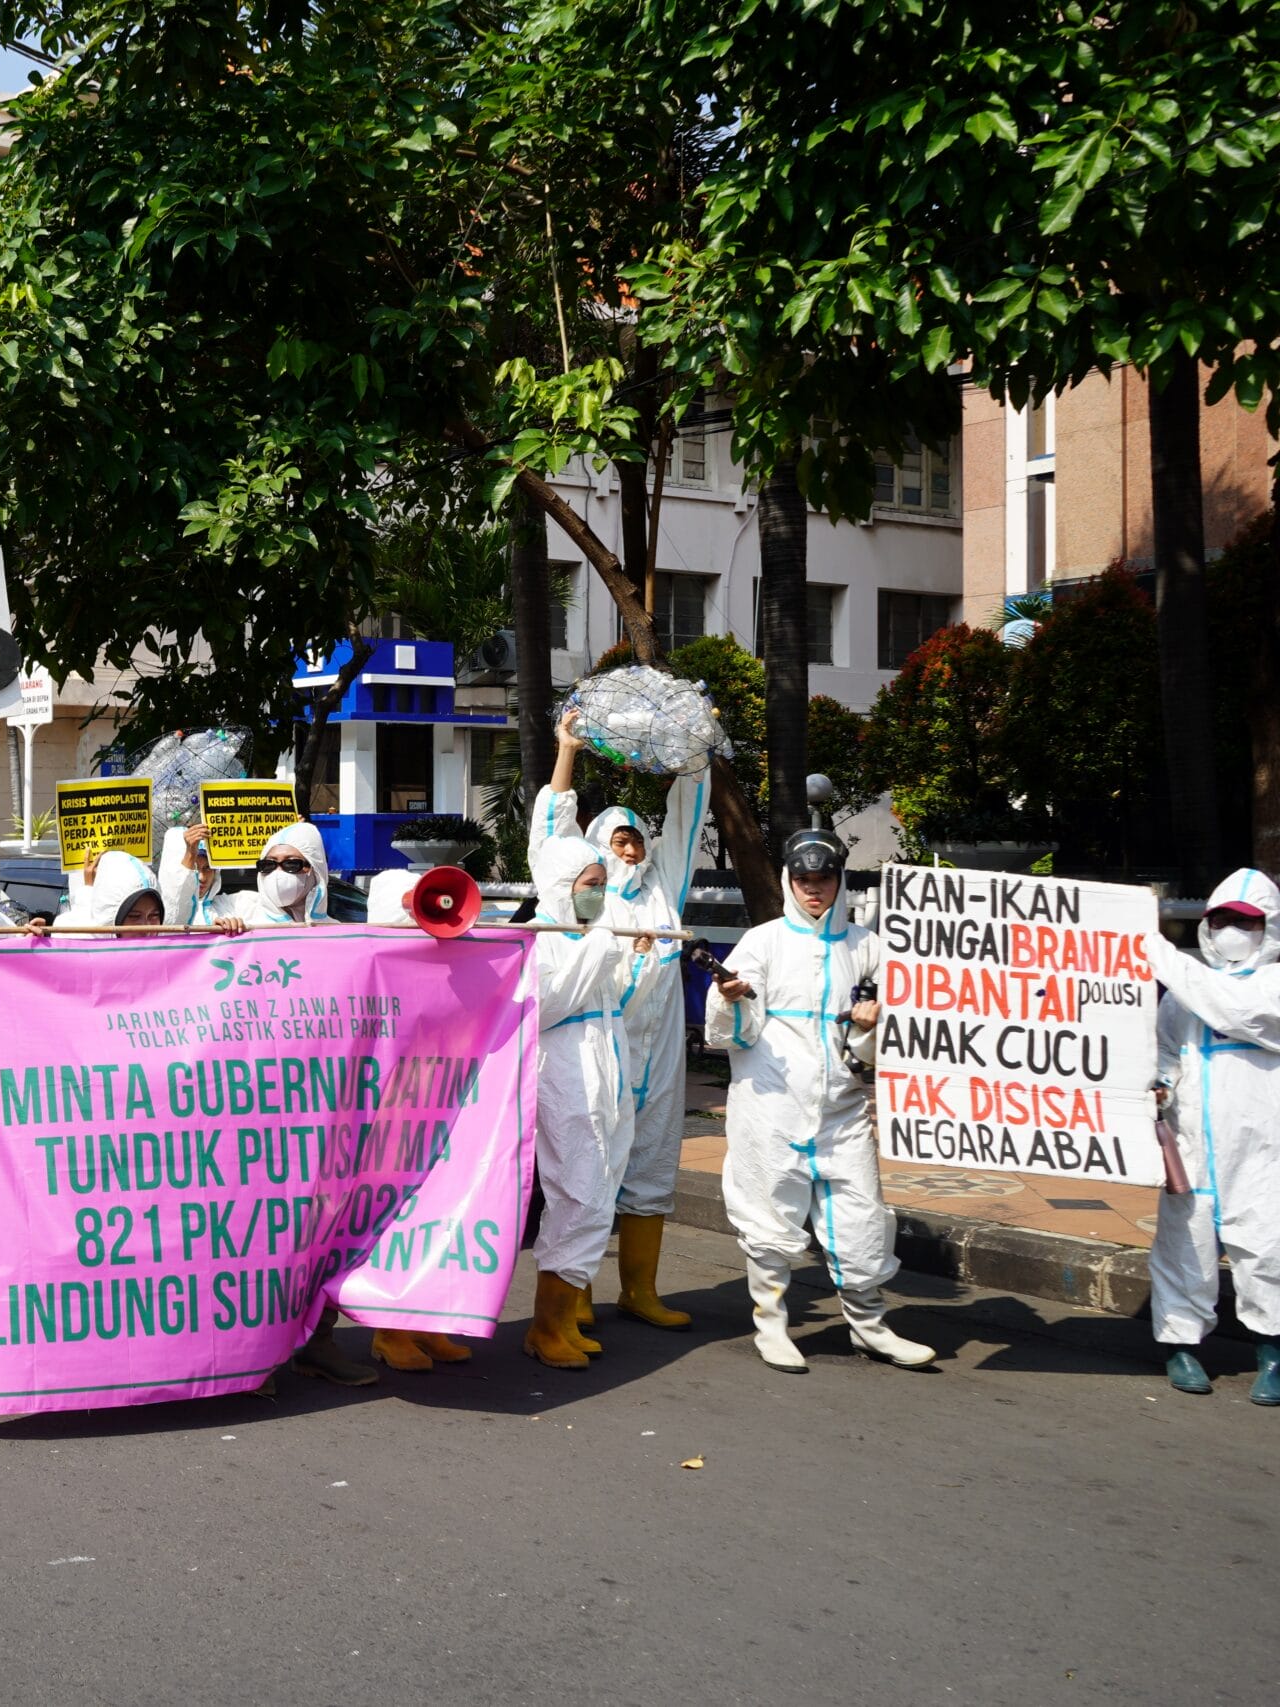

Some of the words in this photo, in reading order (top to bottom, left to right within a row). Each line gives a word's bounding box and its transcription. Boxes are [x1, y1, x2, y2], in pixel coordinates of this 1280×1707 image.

[62, 798, 87, 809] KRISIS
[90, 794, 146, 806] MIKROPLASTIK
[208, 797, 235, 807] KRISIS
[238, 797, 292, 806] MIKROPLASTIK
[64, 817, 78, 827] GEN
[81, 816, 86, 825] Z
[91, 814, 117, 824] JATIM
[120, 812, 146, 821] DUKUNG
[64, 828, 96, 840] PERDA
[101, 824, 146, 836] LARANGAN
[210, 816, 227, 824] GEN
[230, 815, 234, 823] Z
[238, 815, 262, 823] JATIM
[265, 814, 294, 822] DUKUNG
[211, 827, 242, 836] PERDA
[246, 826, 288, 836] LARANG
[67, 840, 99, 851] PLASTIK
[102, 837, 126, 847] SEKALI
[128, 836, 145, 844] PAKAI
[213, 839, 244, 848] PLASTIK
[885, 868, 1080, 923] IKAN-IKAN
[885, 914, 1009, 966] SUNGAI
[1010, 924, 1153, 982] BRANTAS
[886, 960, 1078, 1022] DIBANTAI
[107, 1004, 211, 1030] JARINGAN
[221, 1000, 260, 1020] GEN
[268, 999, 279, 1018] Z
[290, 996, 340, 1017] JAWA
[348, 996, 401, 1017] TIMUR
[126, 1028, 190, 1049] TOLAK
[197, 1020, 276, 1042] PLASTIK
[283, 1019, 344, 1040] SEKALI
[351, 1019, 397, 1039] PAKAI
[881, 1014, 986, 1068] ANAK
[996, 1024, 1108, 1082] CUCU
[0, 1061, 156, 1127] MINTA
[171, 1056, 381, 1118] GUBERNUR
[384, 1056, 479, 1110] JATIM
[878, 1071, 957, 1120] TAK
[970, 1077, 1106, 1133] DISISAI
[35, 1130, 226, 1196] TUNDUK
[394, 1120, 451, 1172] MA
[891, 1118, 1020, 1166] NEGARA
[1026, 1131, 1128, 1176] ABAI
[76, 1206, 163, 1268] 821
